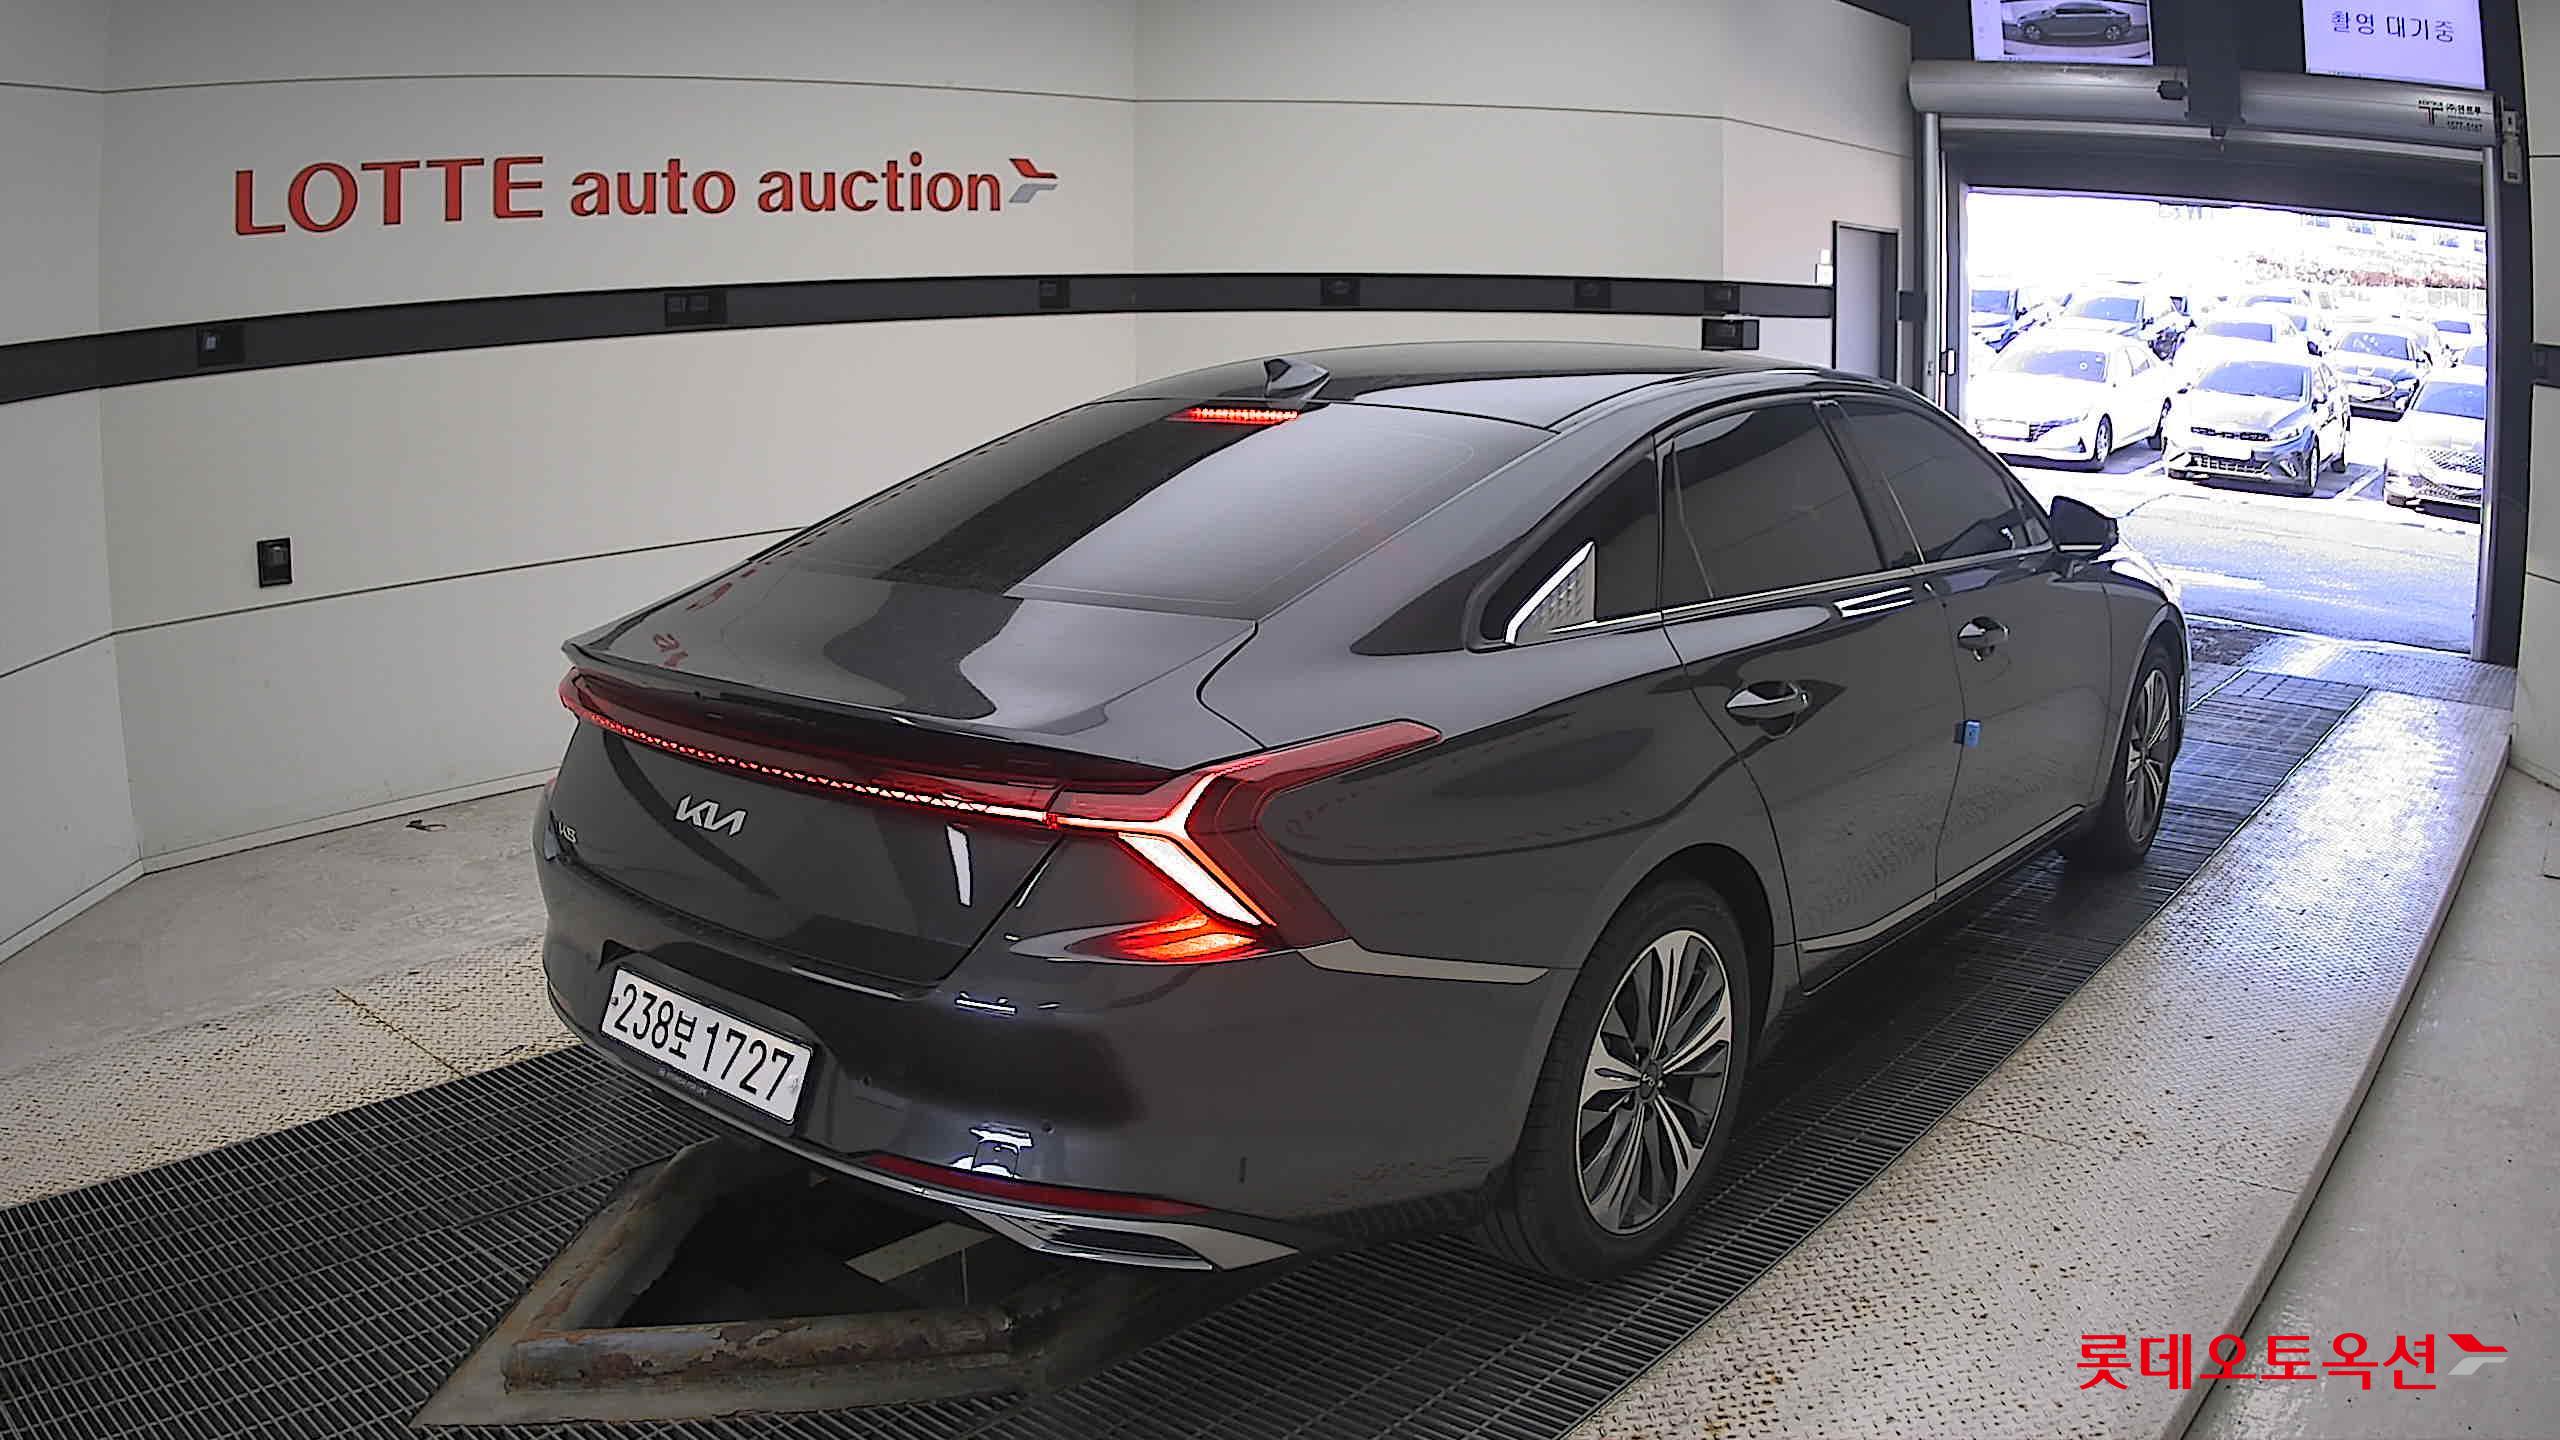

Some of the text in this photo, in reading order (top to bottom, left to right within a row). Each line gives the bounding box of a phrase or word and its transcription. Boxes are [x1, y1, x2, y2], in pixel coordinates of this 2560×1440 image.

[2331, 11, 2454, 43] 촬영 대기중
[235, 151, 1002, 236] LOTTE auto auction
[675, 794, 747, 837] KIA
[613, 983, 698, 1060] 238보
[702, 1020, 795, 1102] 1727
